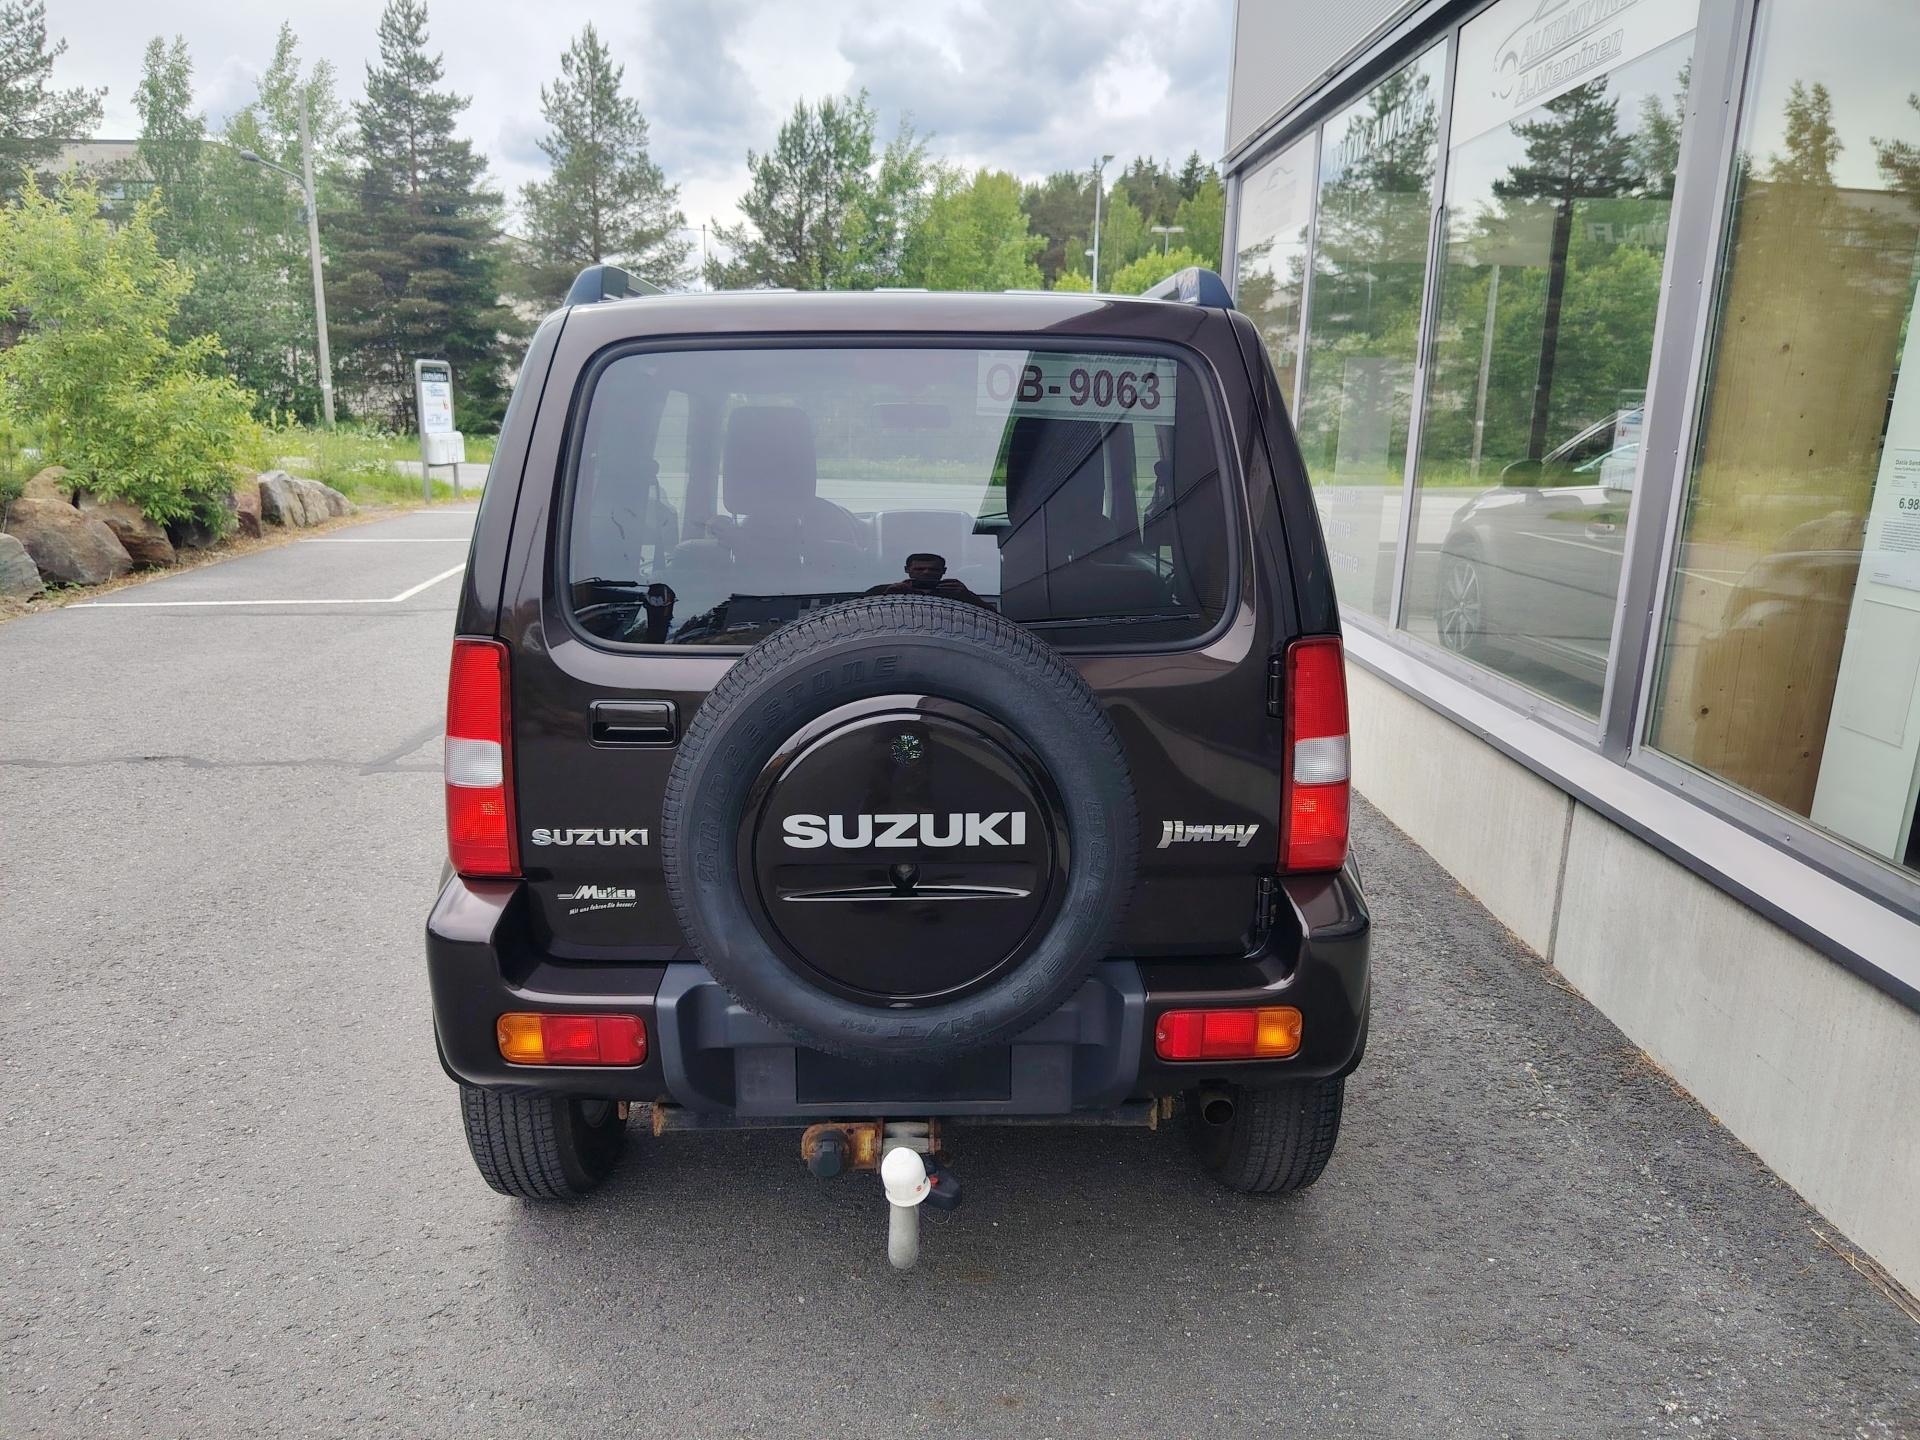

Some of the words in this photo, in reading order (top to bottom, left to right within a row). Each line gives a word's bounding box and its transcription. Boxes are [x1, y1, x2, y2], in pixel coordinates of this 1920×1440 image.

[986, 364, 1160, 410] OB-9063
[1899, 497, 1920, 511] 6.98
[694, 653, 900, 886] BRIDGESTONE
[531, 828, 649, 846] SUZUKI
[782, 811, 1026, 849] SUZUKI
